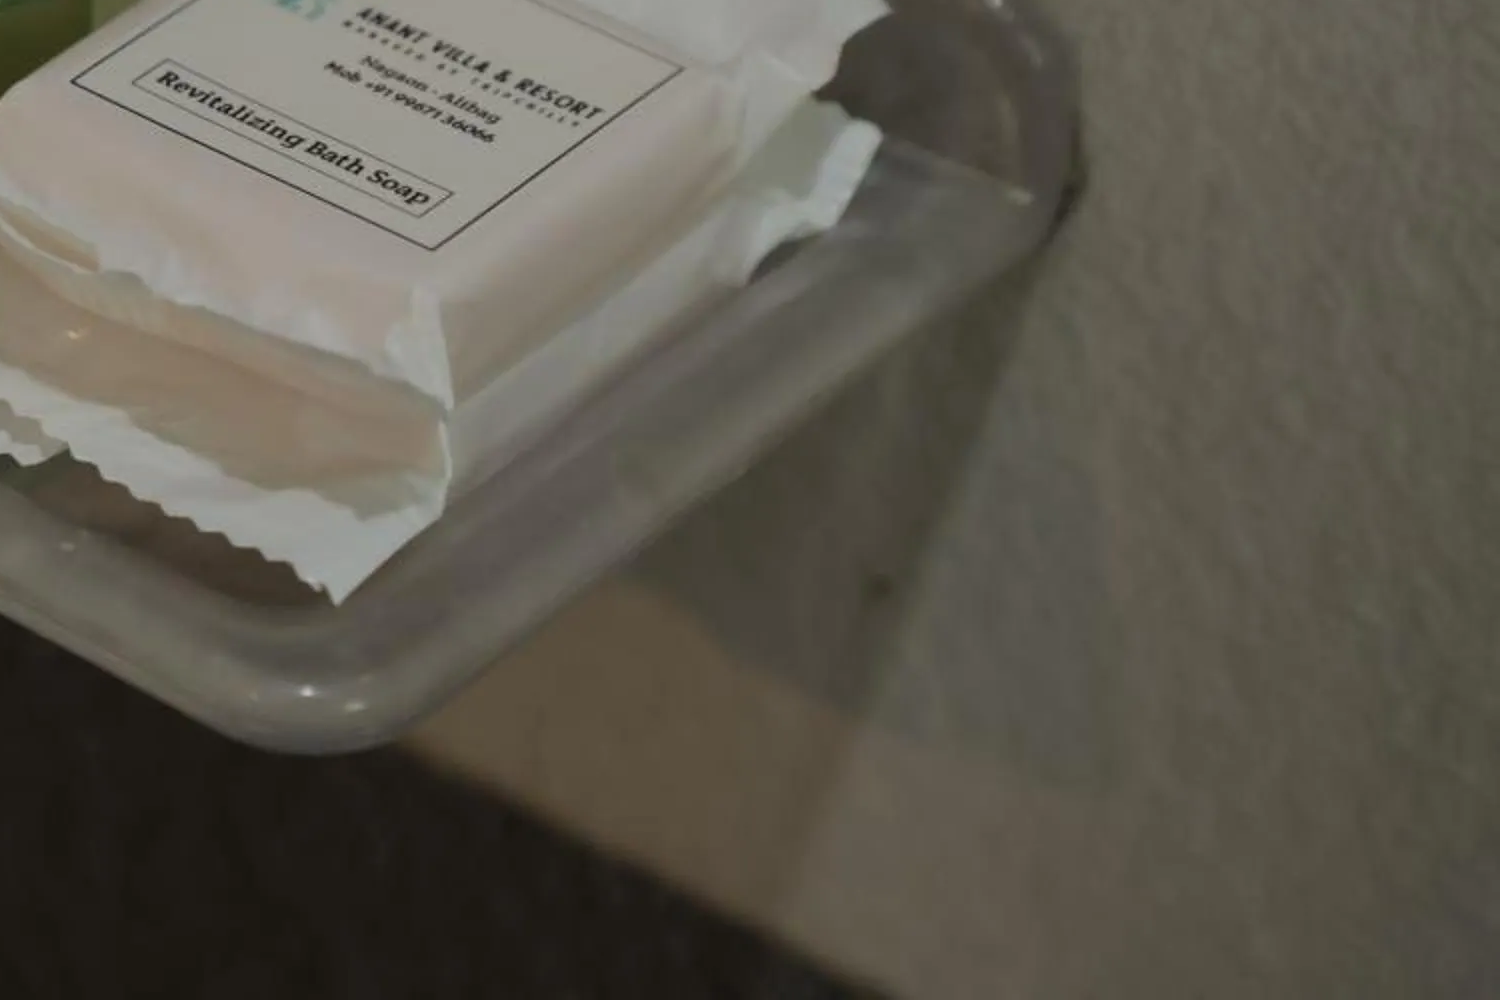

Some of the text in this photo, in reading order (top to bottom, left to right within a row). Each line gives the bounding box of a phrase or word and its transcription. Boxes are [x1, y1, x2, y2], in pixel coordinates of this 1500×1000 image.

[356, 8, 606, 119] ANANT VILLA & RESORT
[438, 92, 501, 124] Alibag
[156, 70, 430, 205] Revitalizing Bath Soap
